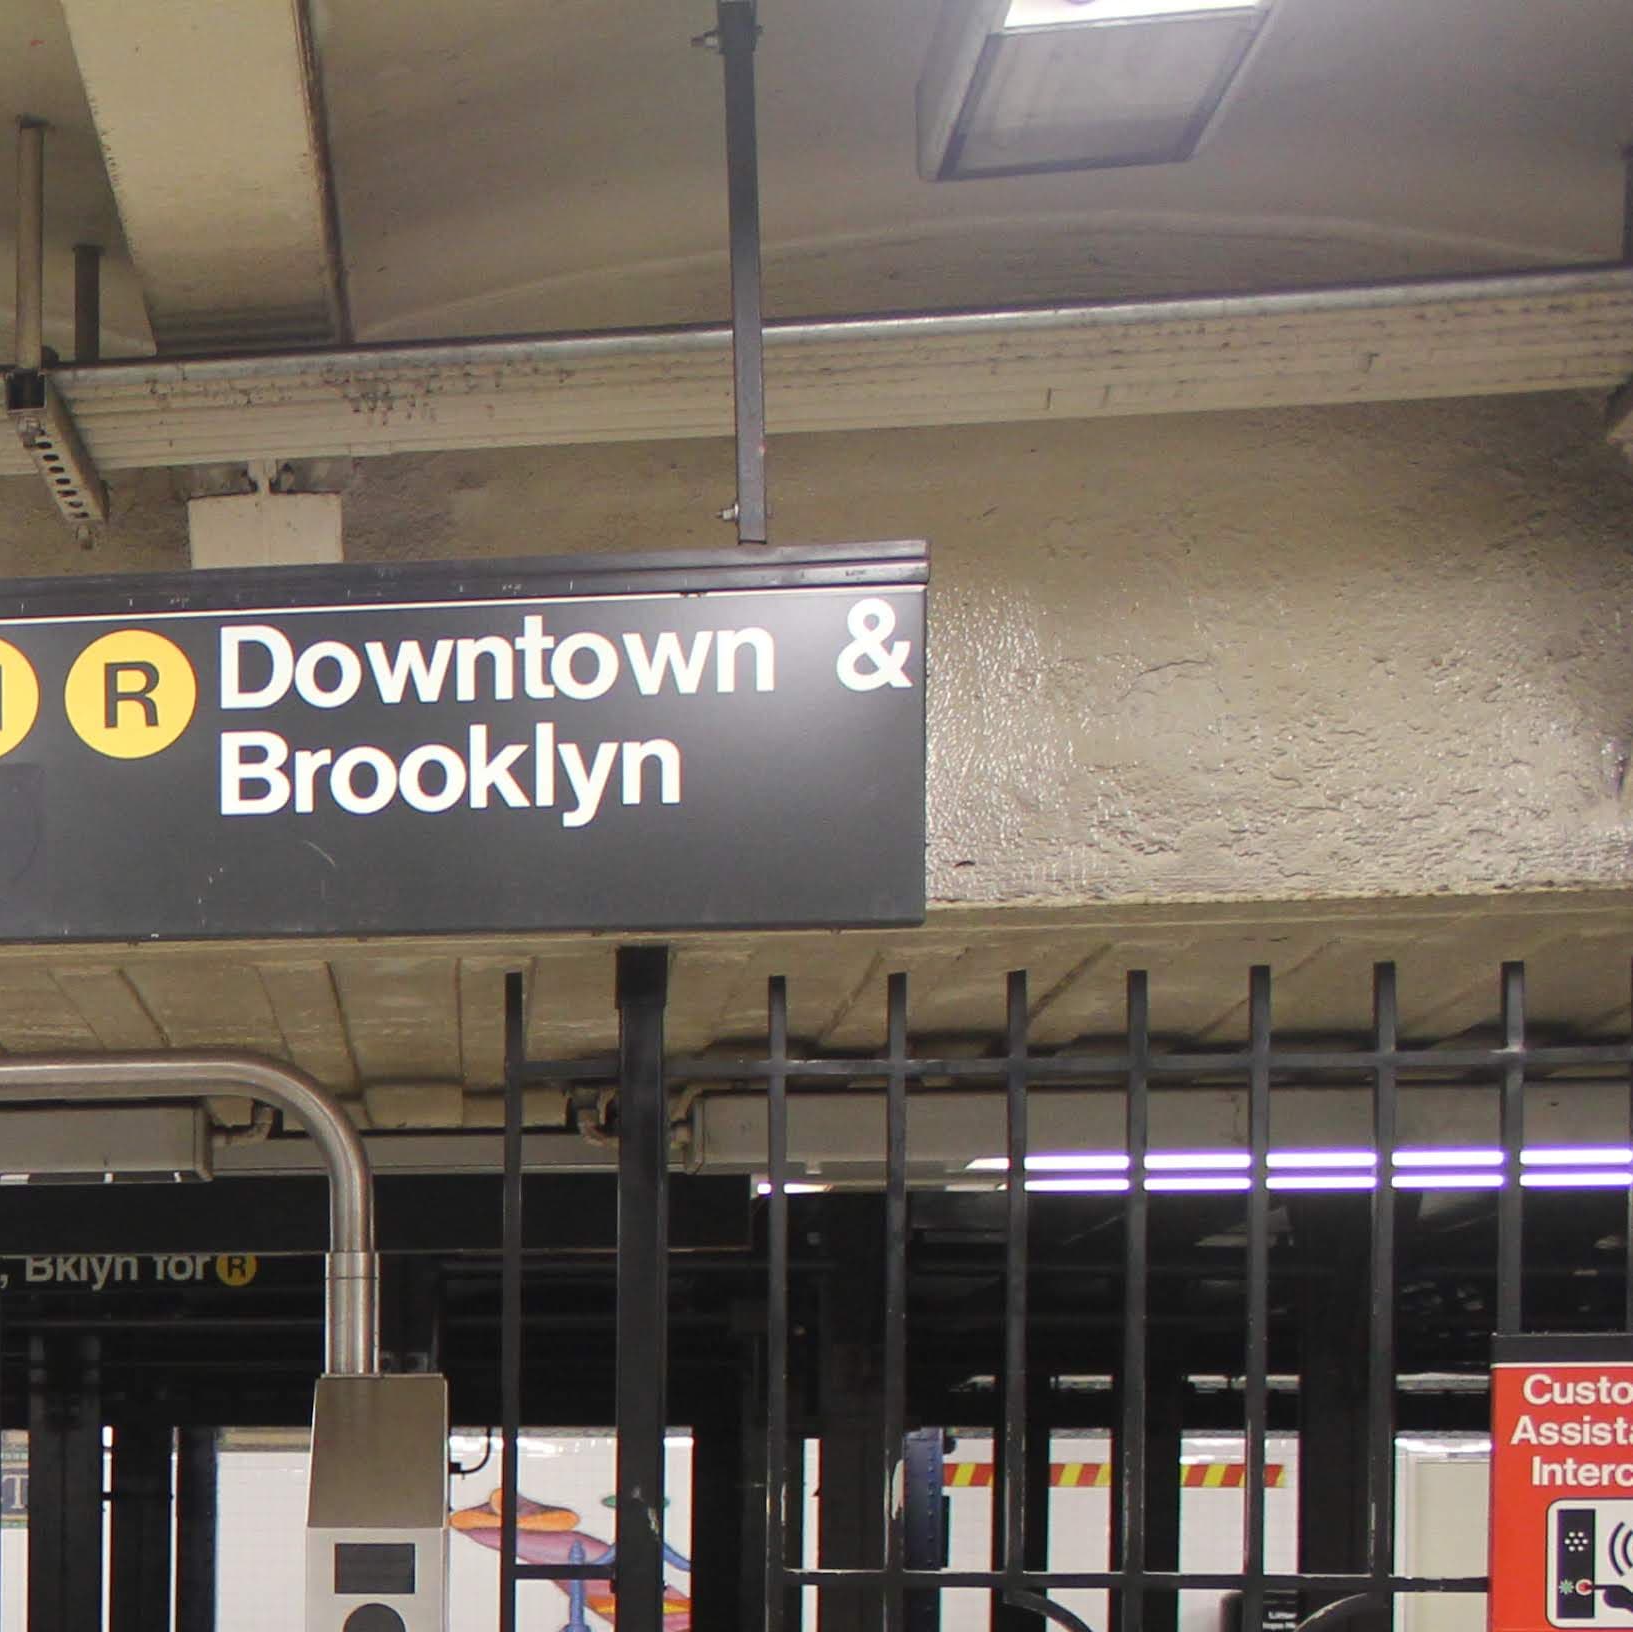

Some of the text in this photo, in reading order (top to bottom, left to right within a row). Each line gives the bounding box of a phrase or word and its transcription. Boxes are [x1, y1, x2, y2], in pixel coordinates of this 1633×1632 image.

[102, 659, 161, 729] R
[219, 613, 776, 715] Downtown
[835, 598, 912, 692] &
[219, 721, 681, 828] Brooklyn
[152, 1253, 213, 1282] for
[1510, 1415, 1633, 1446] Assist
